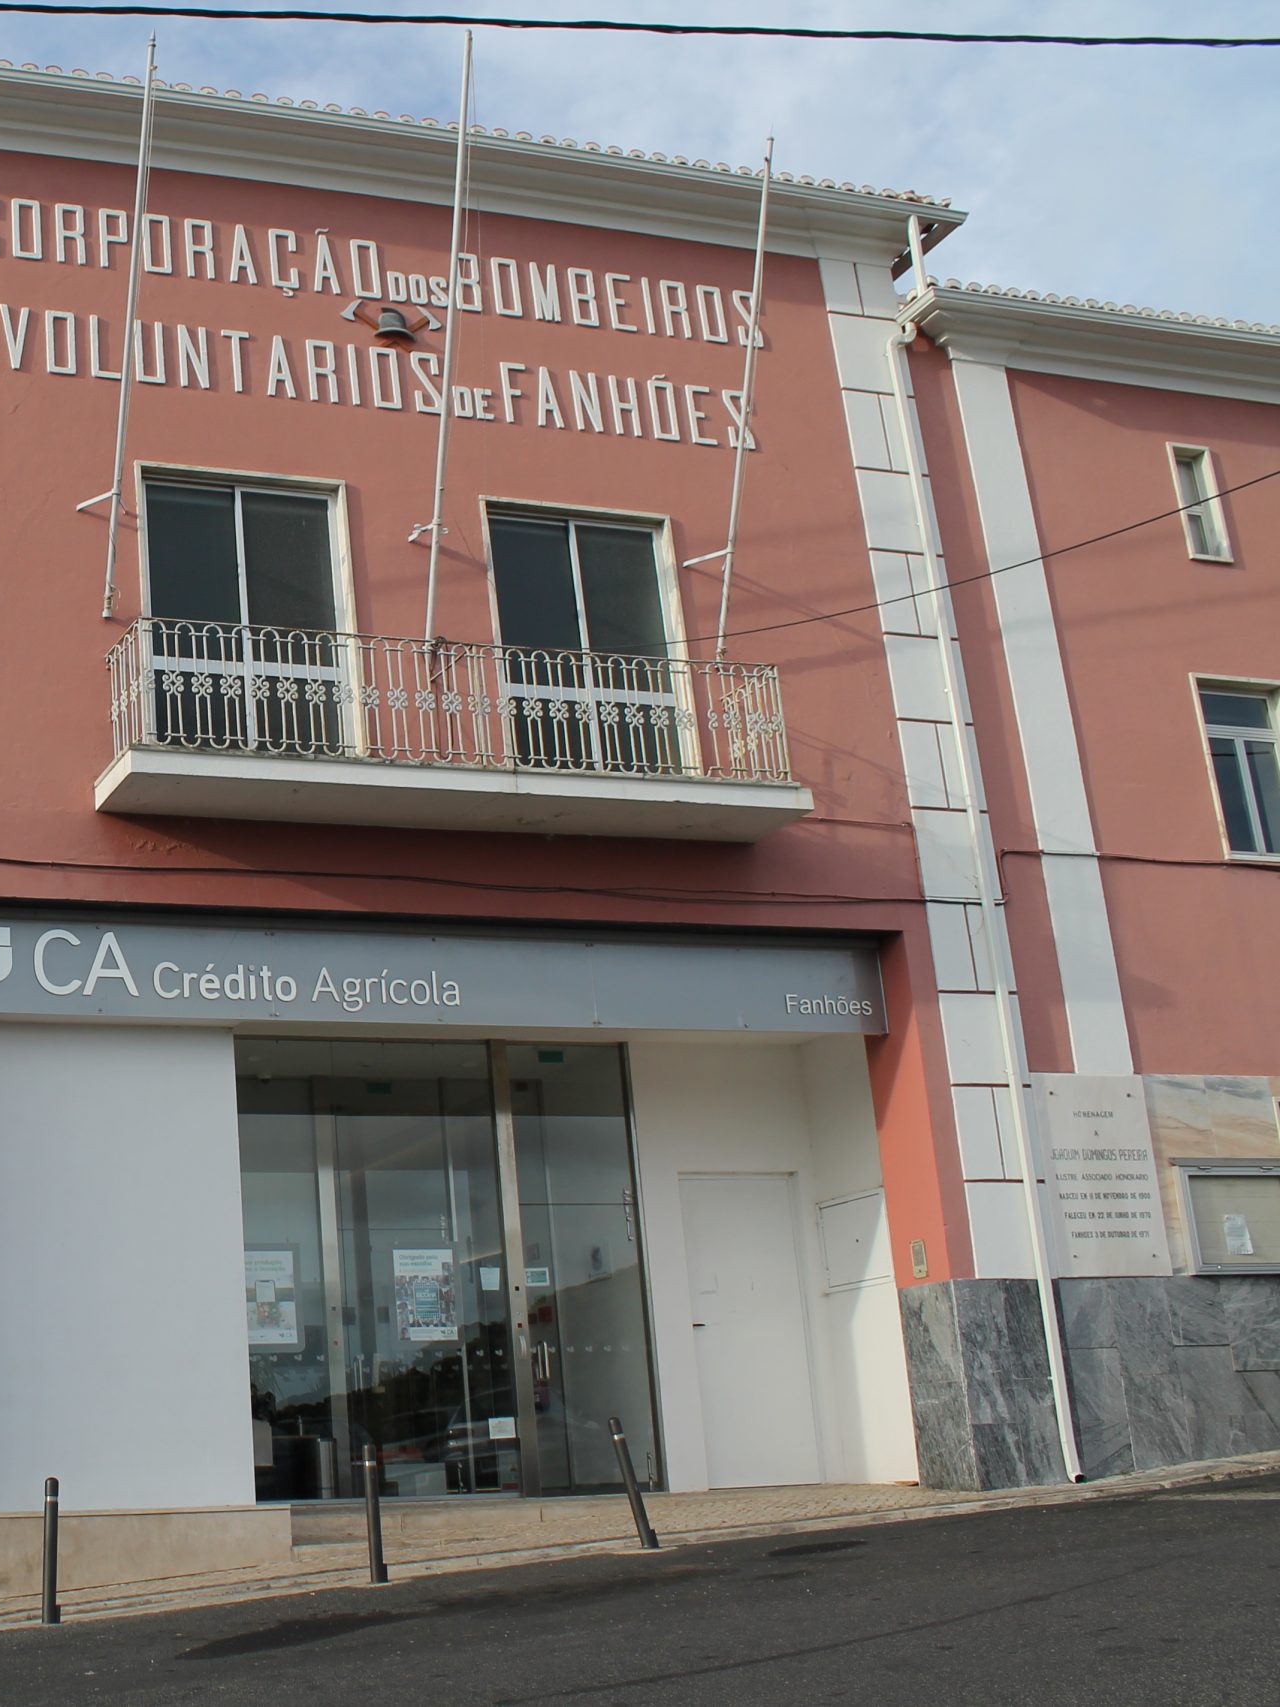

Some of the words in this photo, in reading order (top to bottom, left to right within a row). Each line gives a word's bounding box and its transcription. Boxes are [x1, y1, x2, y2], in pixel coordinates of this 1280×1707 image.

[387, 271, 449, 307] DOS
[456, 252, 764, 348] BOMBEIROS
[0, 303, 442, 414] VOLUNTARIOS
[452, 385, 495, 420] DE
[500, 361, 756, 450] FANHÕES
[33, 928, 140, 997] CA
[153, 961, 298, 1002] Crédito
[311, 967, 461, 1013] Agrícola
[785, 993, 873, 1016] Fanhões
[1081, 1148, 1117, 1161] DOMINGOS
[1118, 1149, 1148, 1161] PEREIRA
